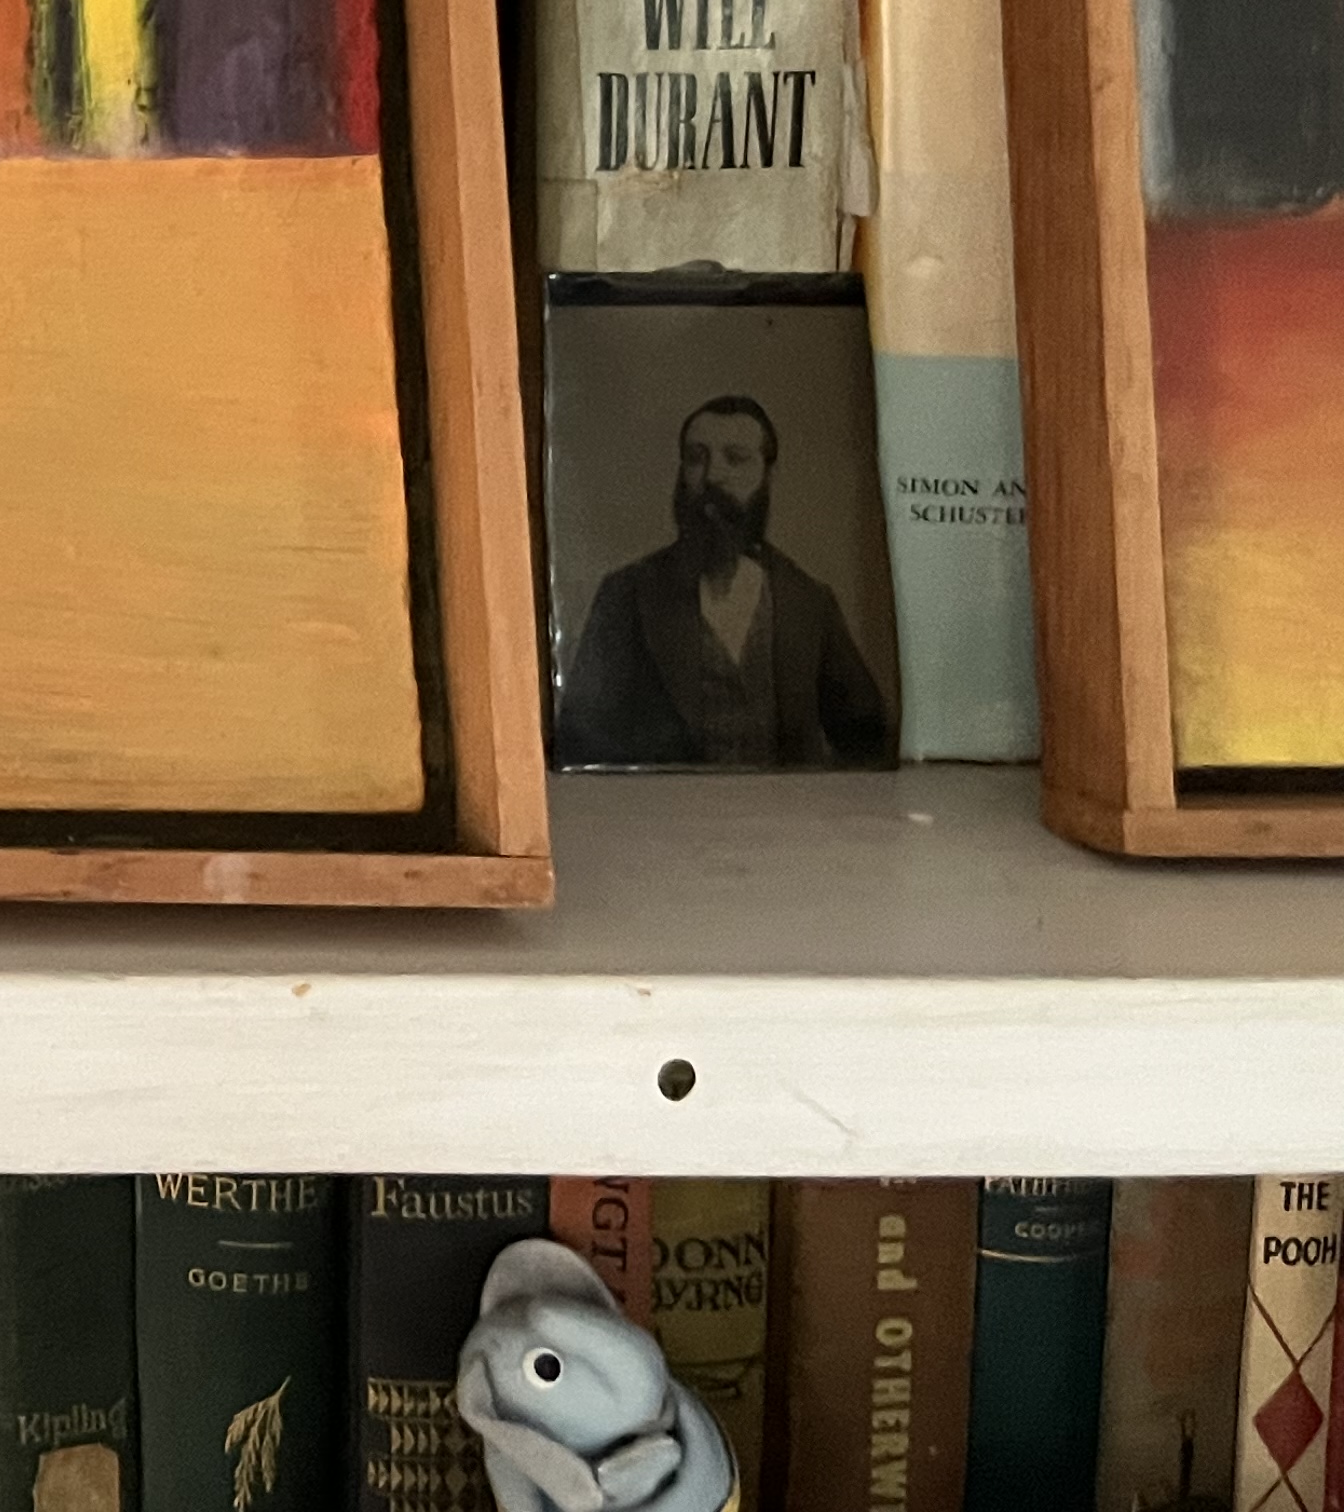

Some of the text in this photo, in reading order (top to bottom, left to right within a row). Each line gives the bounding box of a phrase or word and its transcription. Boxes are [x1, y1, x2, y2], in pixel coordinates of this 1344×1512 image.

[595, 70, 816, 172] DURANT
[897, 476, 1027, 498] SIMON AN
[371, 1175, 535, 1221] Faustus
[1280, 1180, 1330, 1213] THE
[877, 1214, 918, 1292] and
[1263, 1235, 1338, 1267] POOH
[187, 1268, 310, 1295] GOETHE
[16, 1396, 130, 1445] Kipling
